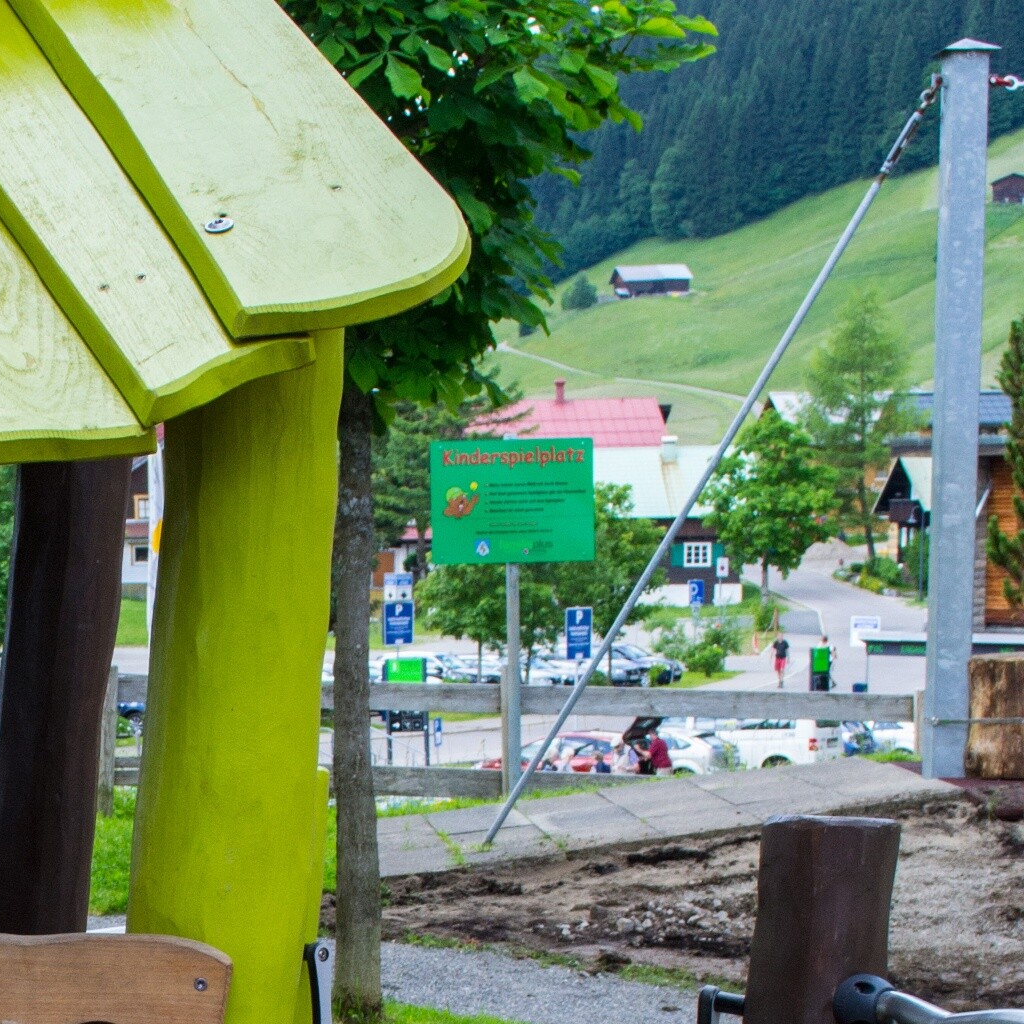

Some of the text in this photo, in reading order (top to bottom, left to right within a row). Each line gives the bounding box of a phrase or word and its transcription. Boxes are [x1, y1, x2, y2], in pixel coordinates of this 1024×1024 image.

[443, 446, 585, 469] Kinderspielplatz
[395, 603, 403, 616] P
[576, 610, 583, 625] P
